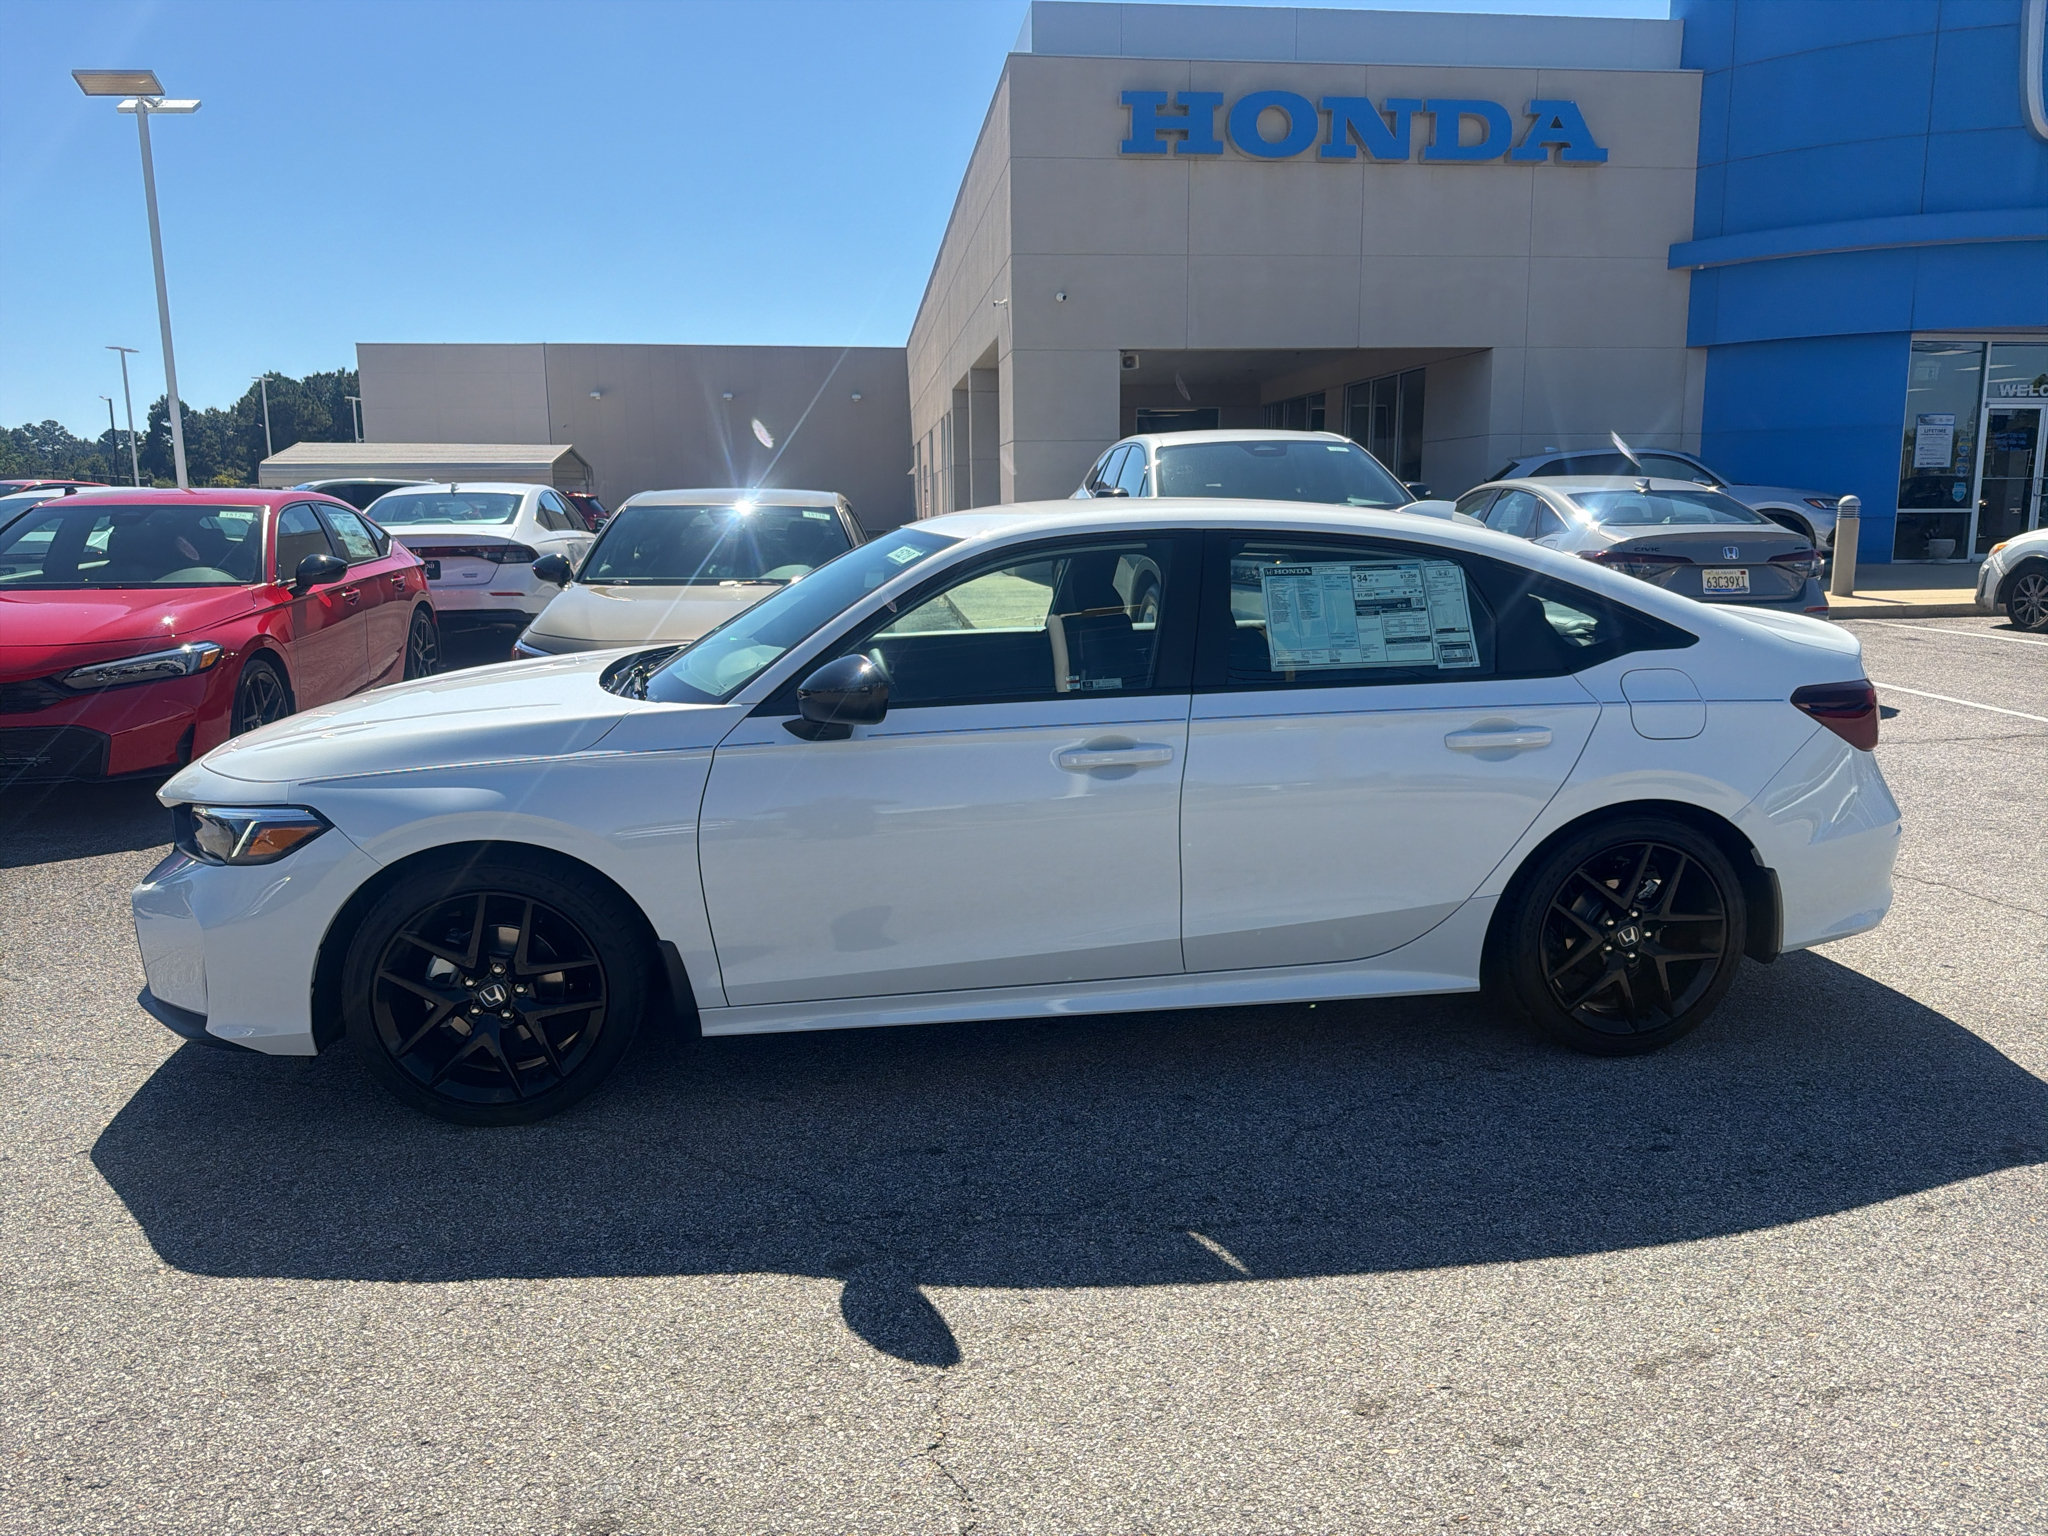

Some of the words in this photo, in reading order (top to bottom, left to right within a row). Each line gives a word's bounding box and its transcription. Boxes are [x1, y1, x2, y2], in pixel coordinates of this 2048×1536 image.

[1120, 90, 1608, 163] HONDA
[1356, 574, 1368, 583] 34
[1706, 576, 1746, 589] 63C39X1
